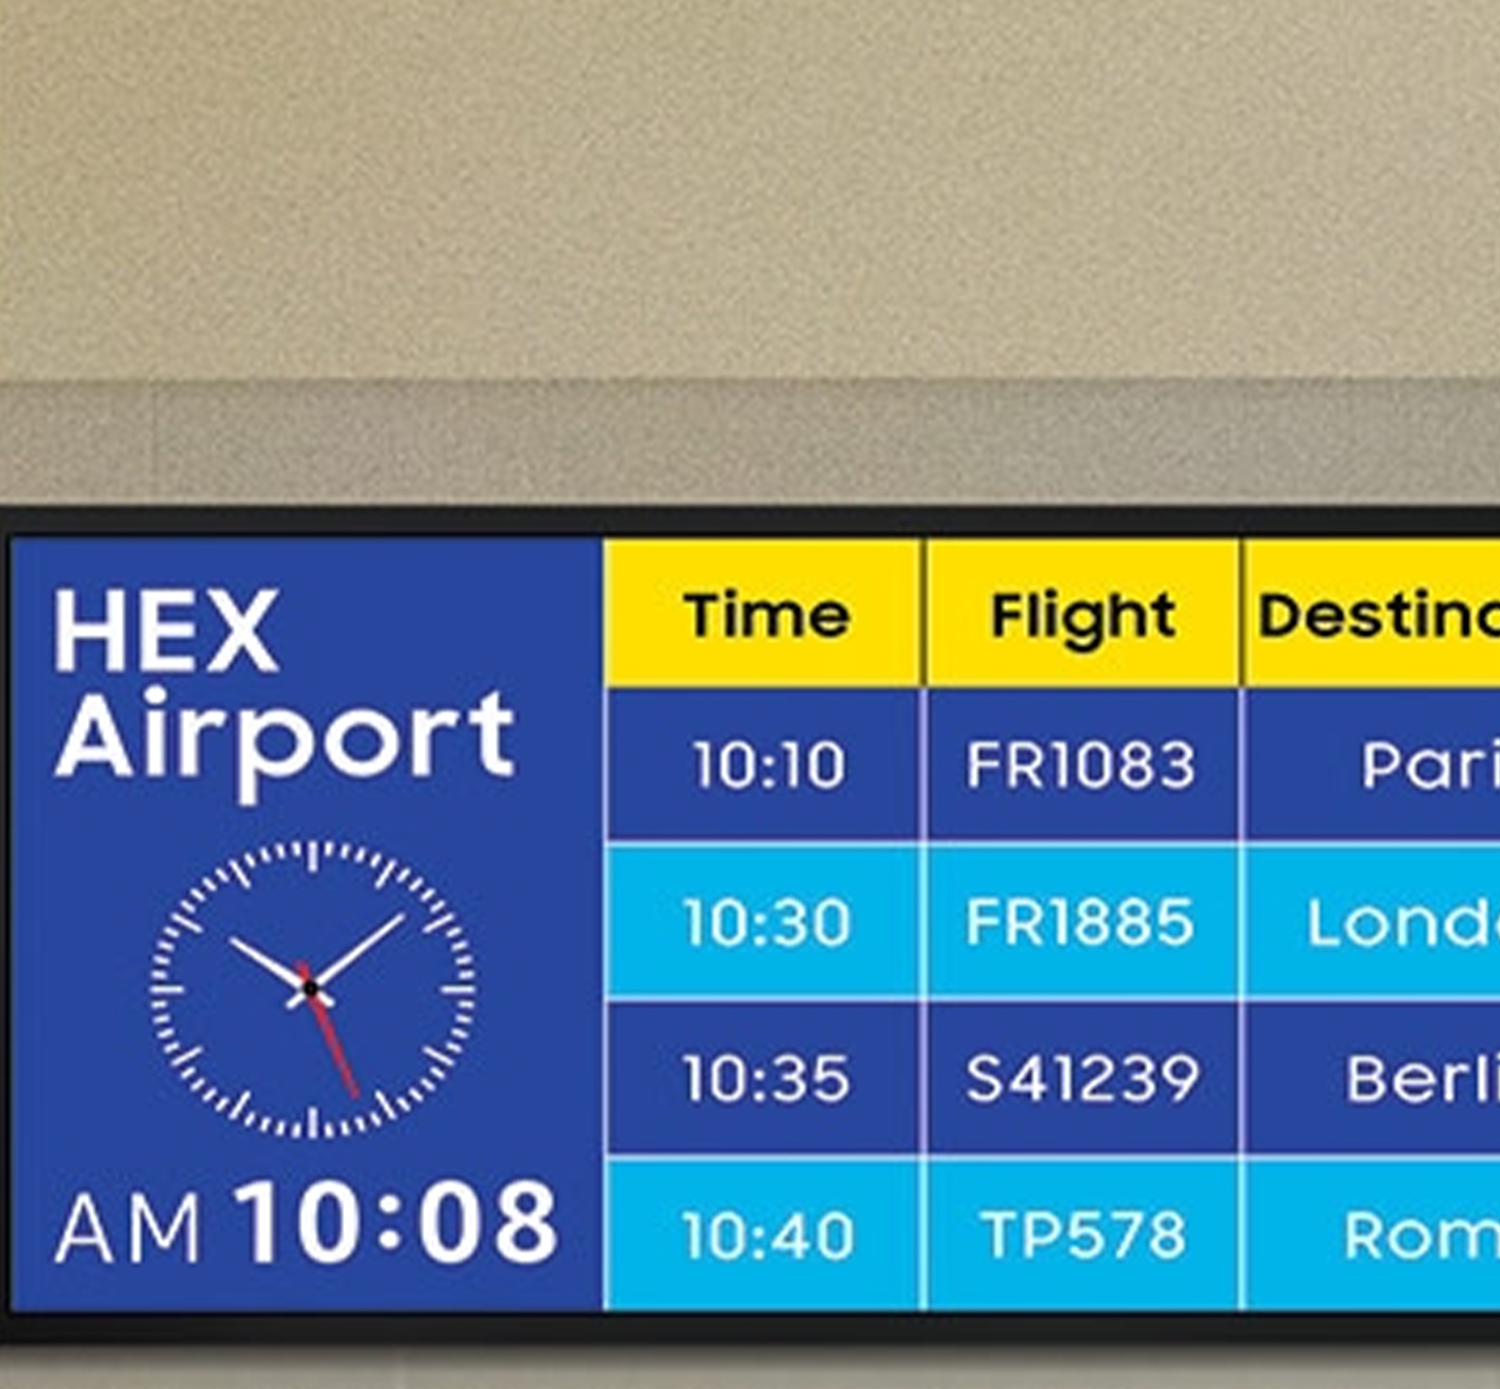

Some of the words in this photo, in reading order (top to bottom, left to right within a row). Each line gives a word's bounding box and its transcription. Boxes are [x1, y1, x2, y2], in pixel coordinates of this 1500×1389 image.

[57, 589, 278, 671] HEX
[683, 588, 850, 638] Time
[993, 588, 1175, 654] Flight
[55, 685, 513, 805] Airport
[694, 741, 843, 788] 10:10
[970, 741, 1193, 788] FR1083
[685, 898, 849, 946] 10:30
[969, 897, 1193, 945] FR1885
[684, 1055, 848, 1102] 10:35
[969, 1055, 1198, 1101] S41239
[55, 1193, 196, 1262] AM
[235, 1180, 556, 1263] 10:08
[683, 1212, 853, 1260] 10:40
[980, 1211, 1184, 1259] TP578
